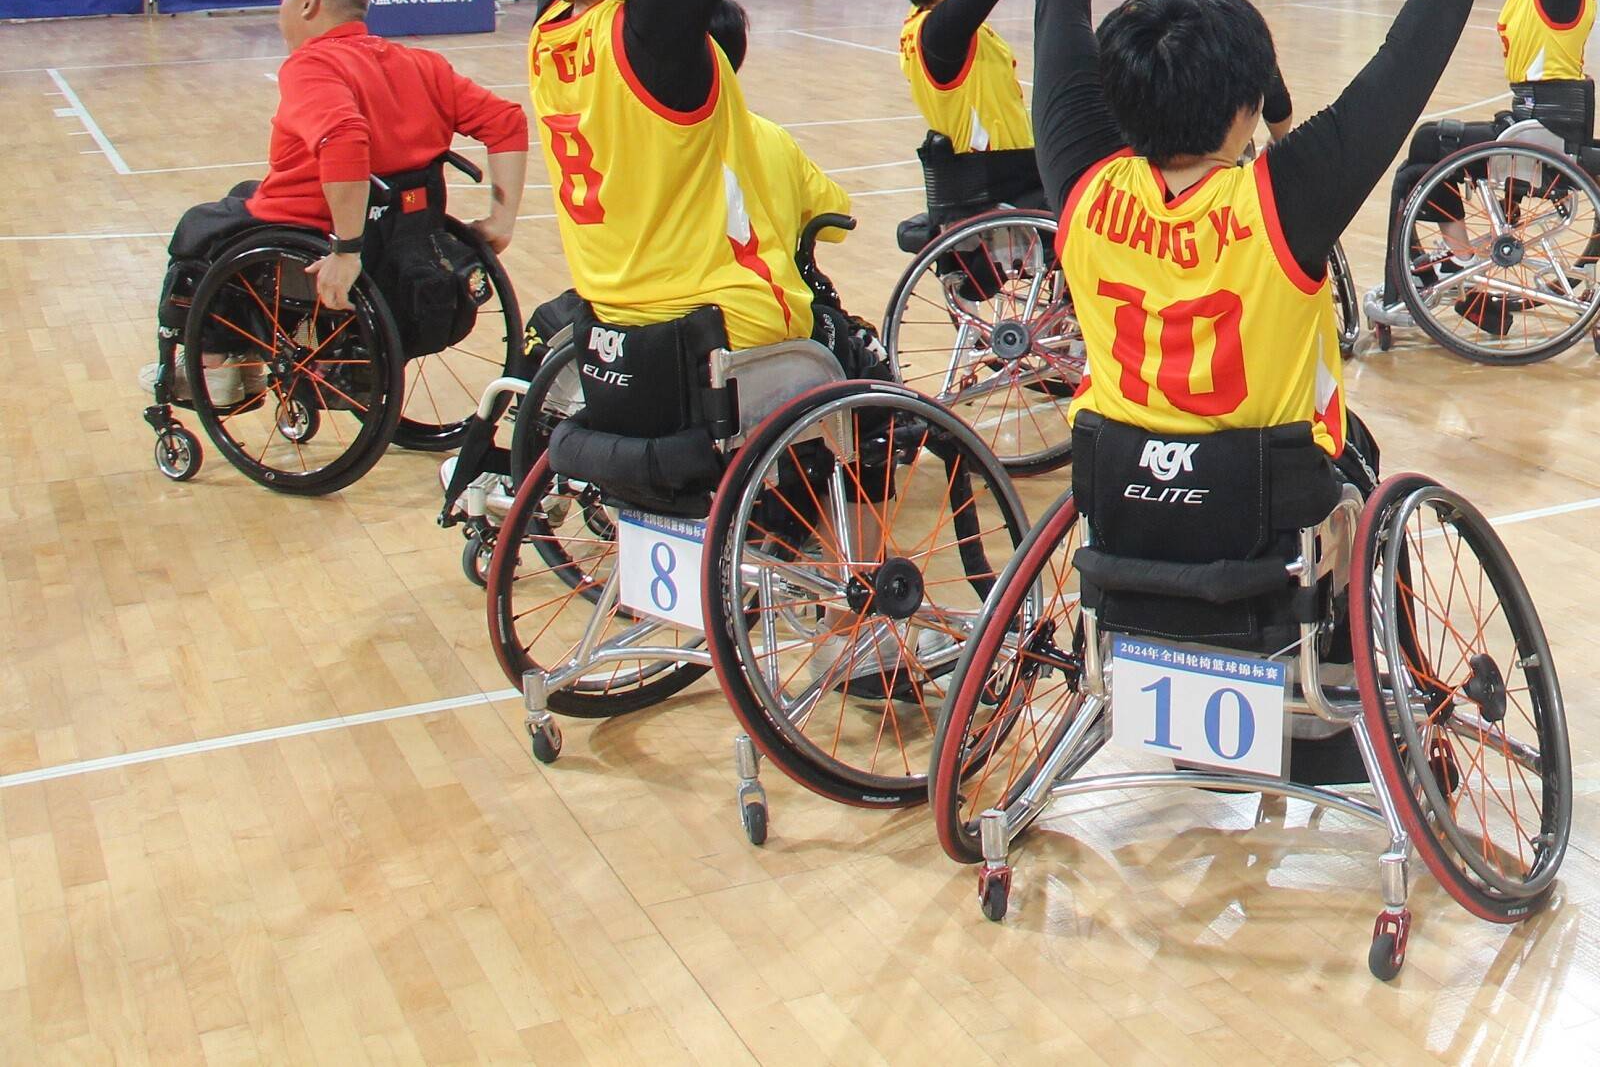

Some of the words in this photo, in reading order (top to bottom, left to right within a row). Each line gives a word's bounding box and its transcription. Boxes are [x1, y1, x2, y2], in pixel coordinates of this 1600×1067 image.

[541, 112, 606, 226] 8
[1086, 180, 1200, 270] HUANG
[582, 363, 633, 387] ELITE
[1096, 278, 1248, 417] 10
[1123, 484, 1210, 505] ELITE
[650, 541, 678, 612] 8
[1120, 641, 1279, 680] 2024年全国轮椅篮球锦标赛
[1140, 676, 1256, 761] 10
